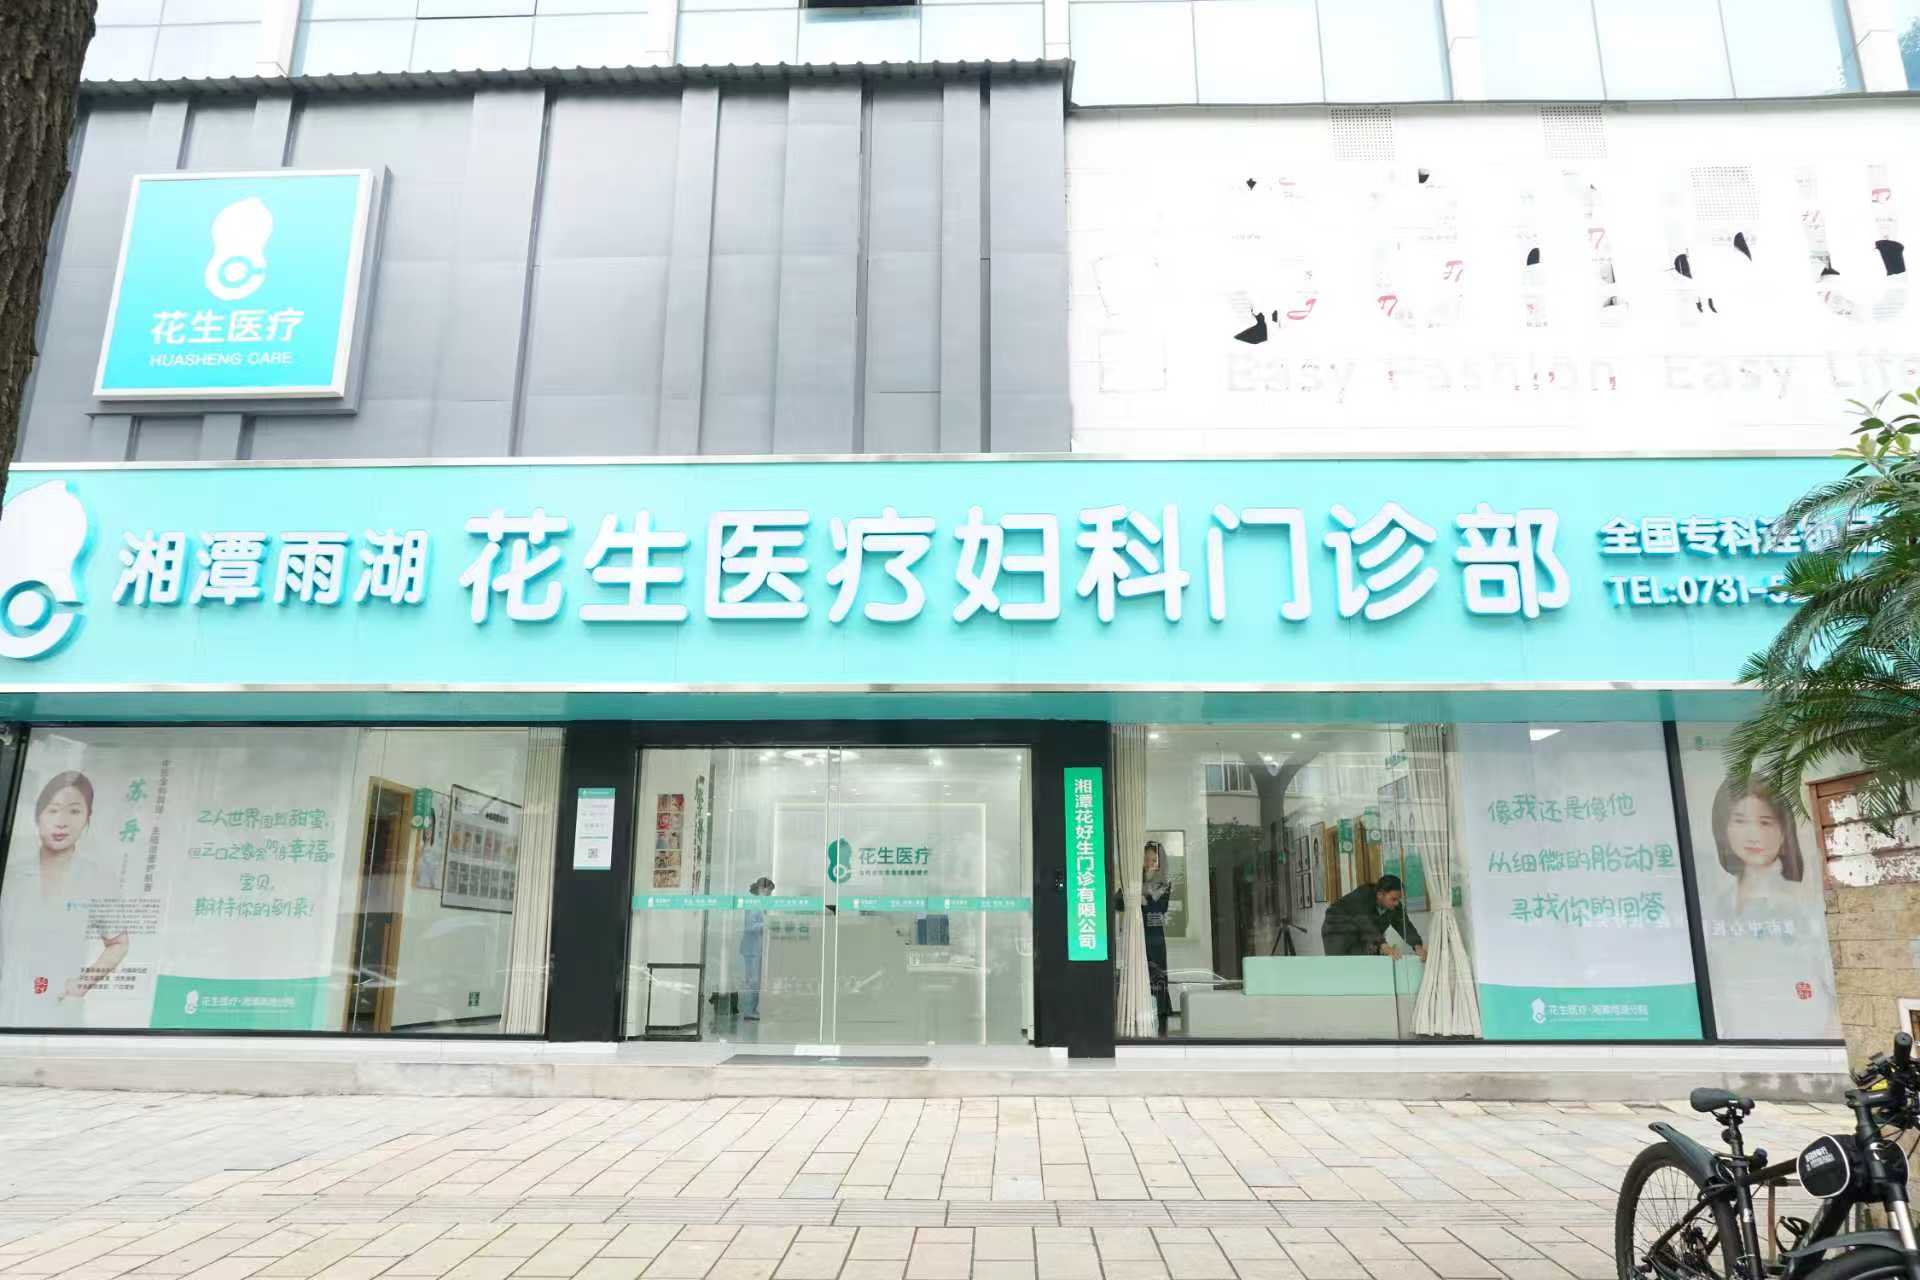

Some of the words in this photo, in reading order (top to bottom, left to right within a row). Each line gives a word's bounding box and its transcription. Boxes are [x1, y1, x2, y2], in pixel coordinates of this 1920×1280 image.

[150, 307, 305, 345] 花生医疗
[149, 353, 242, 366] HUASHENG
[246, 352, 294, 365] CARE
[112, 529, 431, 606] 湘潭雨湖
[459, 502, 1571, 624] 花生医疗妇科门诊部
[1487, 793, 1636, 825] 像我还是像他
[858, 846, 931, 865] 花生医疗
[1074, 779, 1097, 949] 湘潭花好生门诊有限公司
[1488, 842, 1677, 873] 从细微的胎动里
[1510, 892, 1666, 926] 寻找你的回答
